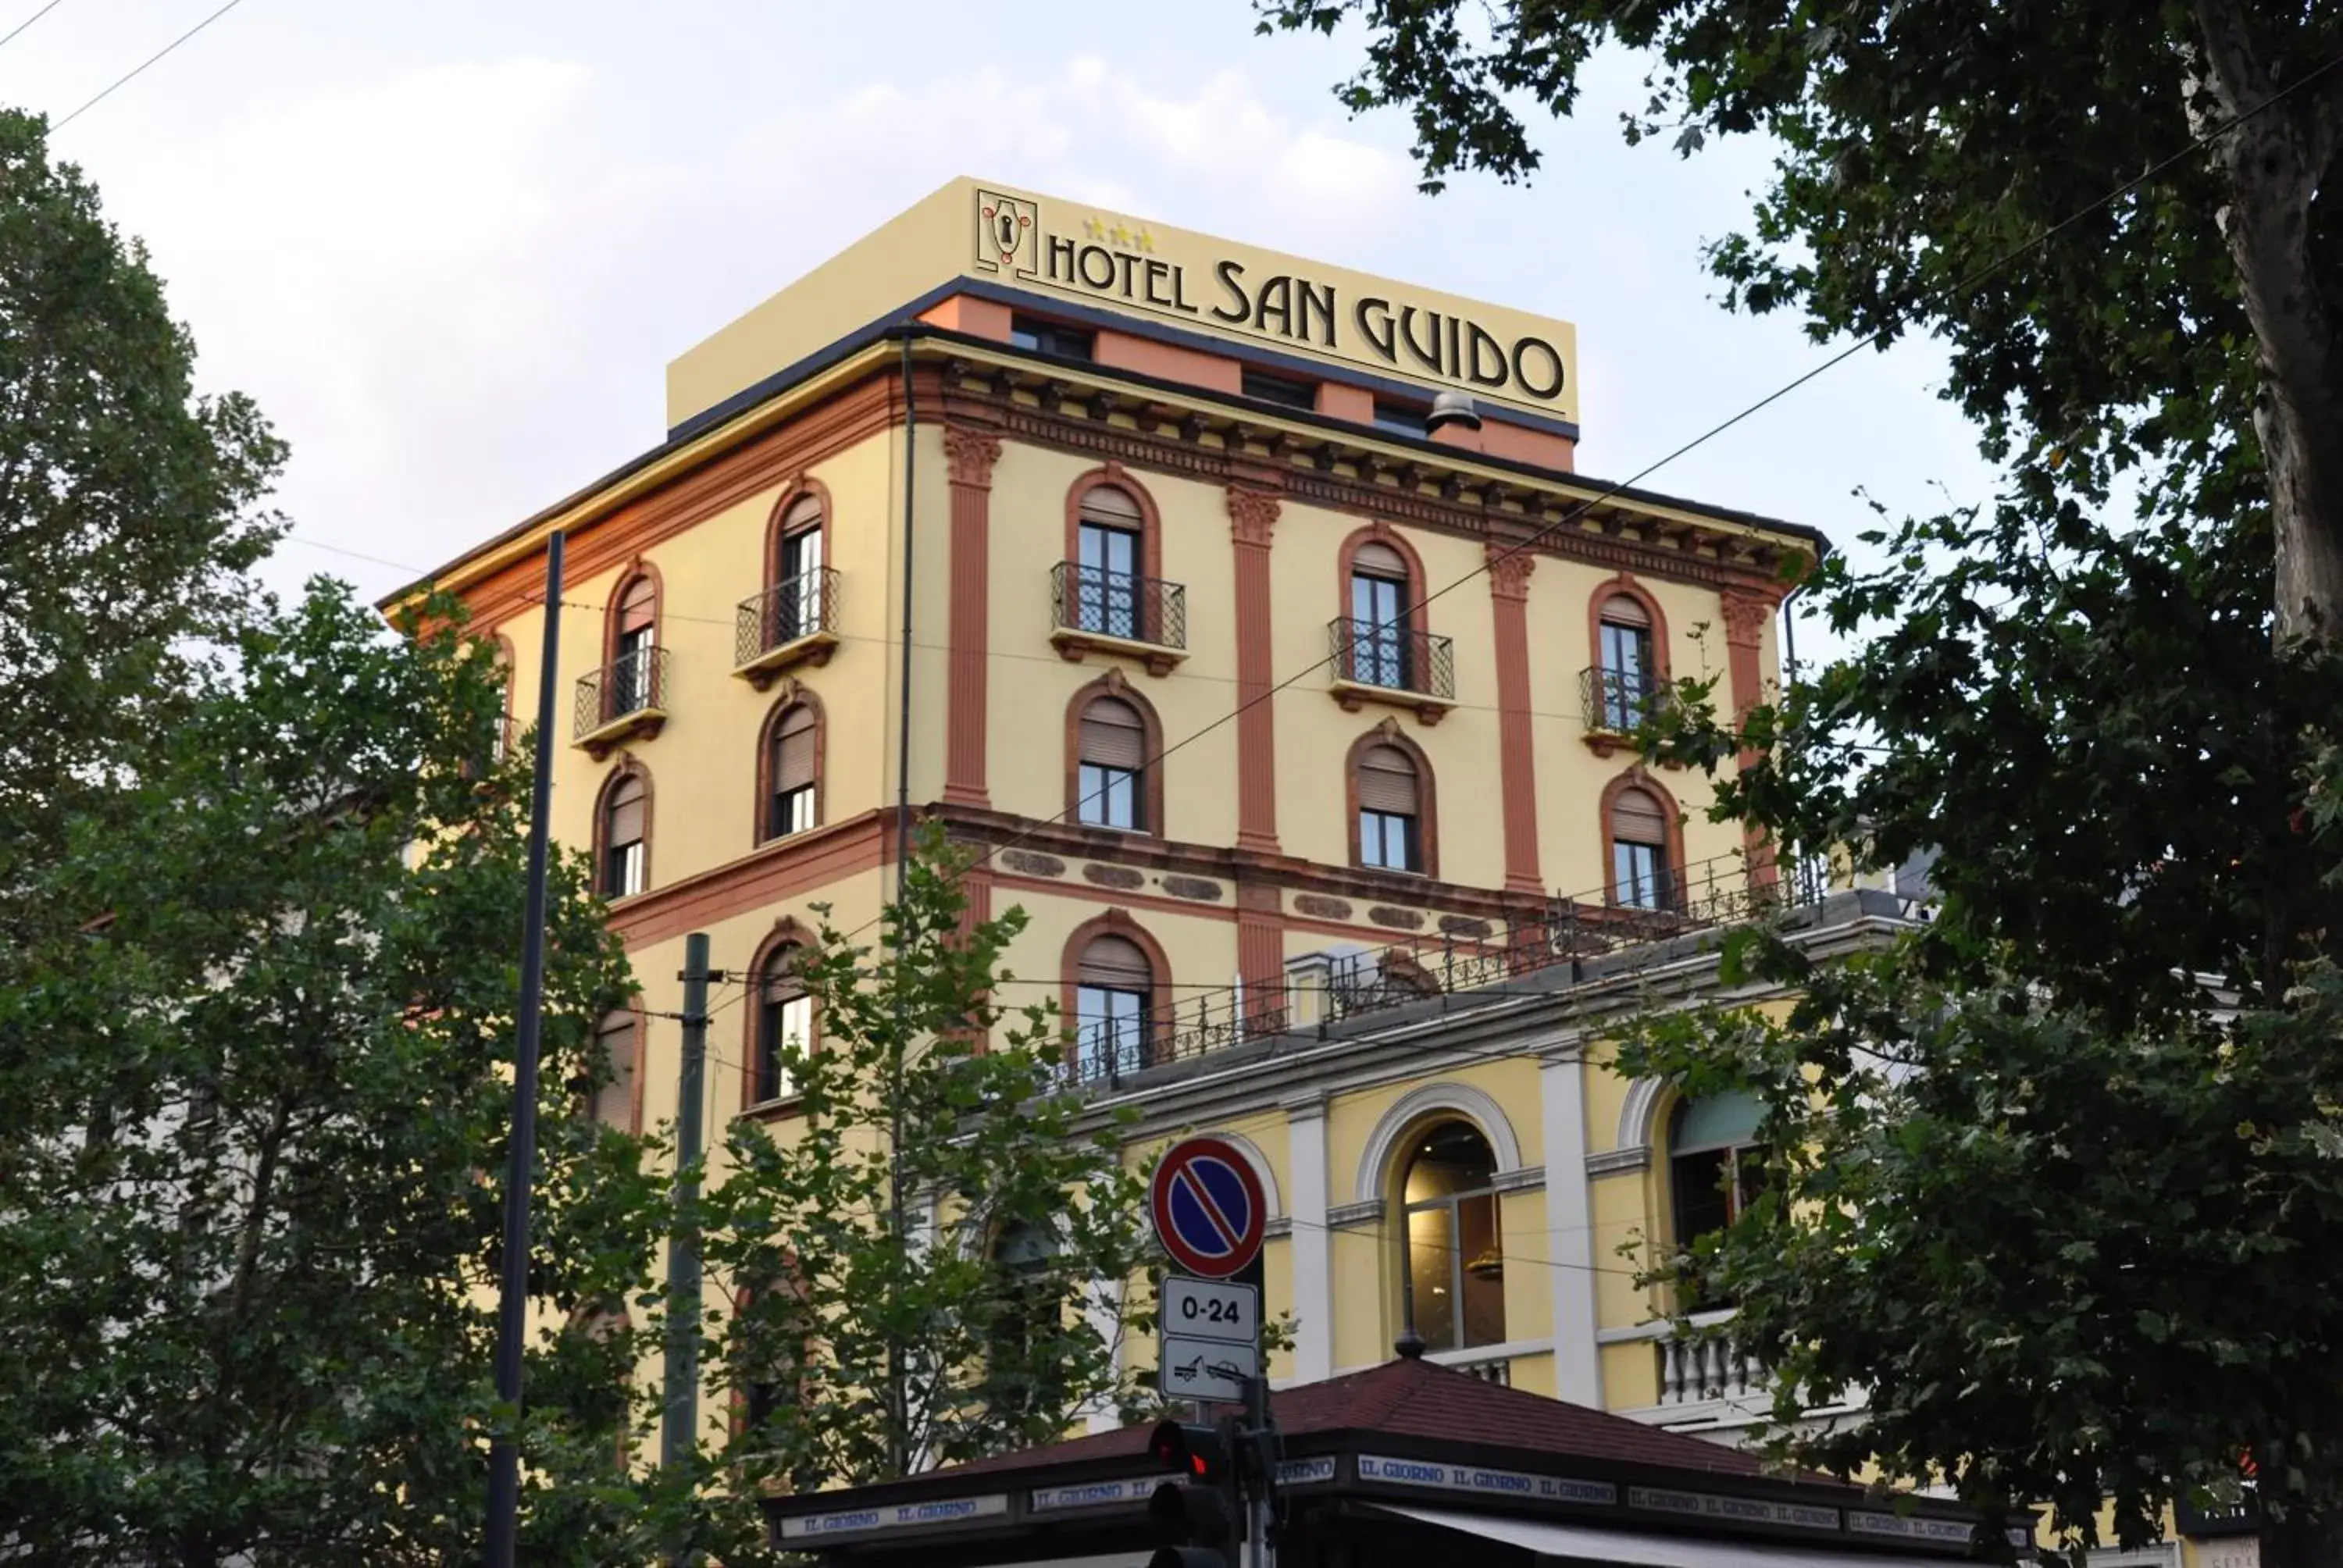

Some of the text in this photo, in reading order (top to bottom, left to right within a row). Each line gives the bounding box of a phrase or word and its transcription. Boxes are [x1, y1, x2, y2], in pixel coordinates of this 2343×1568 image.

[1048, 234, 1564, 400] HOTEL SAN GUIDO
[1182, 1296, 1240, 1324] 0-24
[1038, 1481, 1151, 1506] IL GIORNO IL
[1361, 1460, 1614, 1501] IL GIORNO IL GIORNO IL GIORNO
[805, 1501, 977, 1532] IL GIORNO IL GIORNO
[1631, 1489, 1646, 1505] IL
[1648, 1491, 1699, 1513] GIORNO
[1706, 1498, 1720, 1513] IL
[1723, 1499, 1771, 1519] GIORNO
[1777, 1506, 1790, 1521] IL
